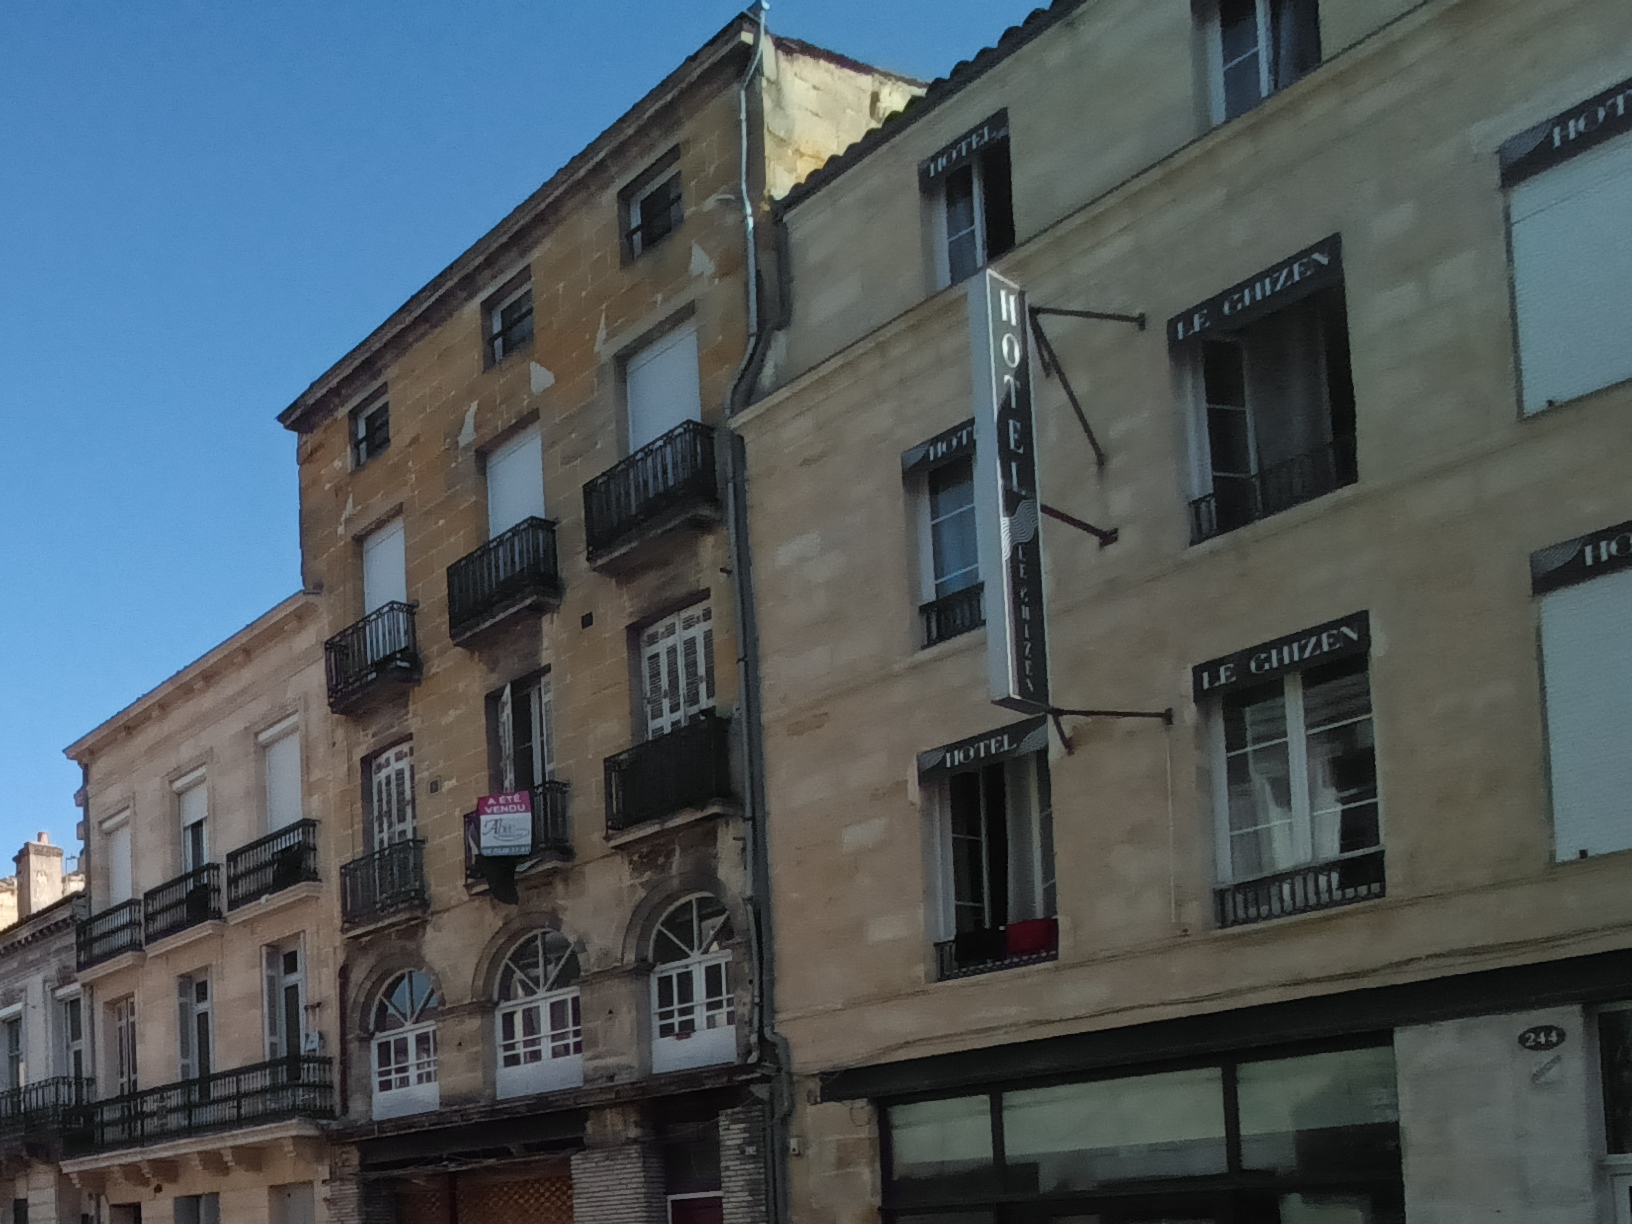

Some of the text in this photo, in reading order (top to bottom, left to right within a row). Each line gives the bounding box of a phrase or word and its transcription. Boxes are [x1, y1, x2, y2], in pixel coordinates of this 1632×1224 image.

[930, 125, 997, 177] HOTEL
[1177, 308, 1210, 340] LE
[999, 288, 1026, 495] HOTEL
[1202, 663, 1236, 691] LE
[946, 734, 1017, 768] HOTEL
[484, 803, 526, 814] VENDU
[1525, 1030, 1558, 1047] 244
